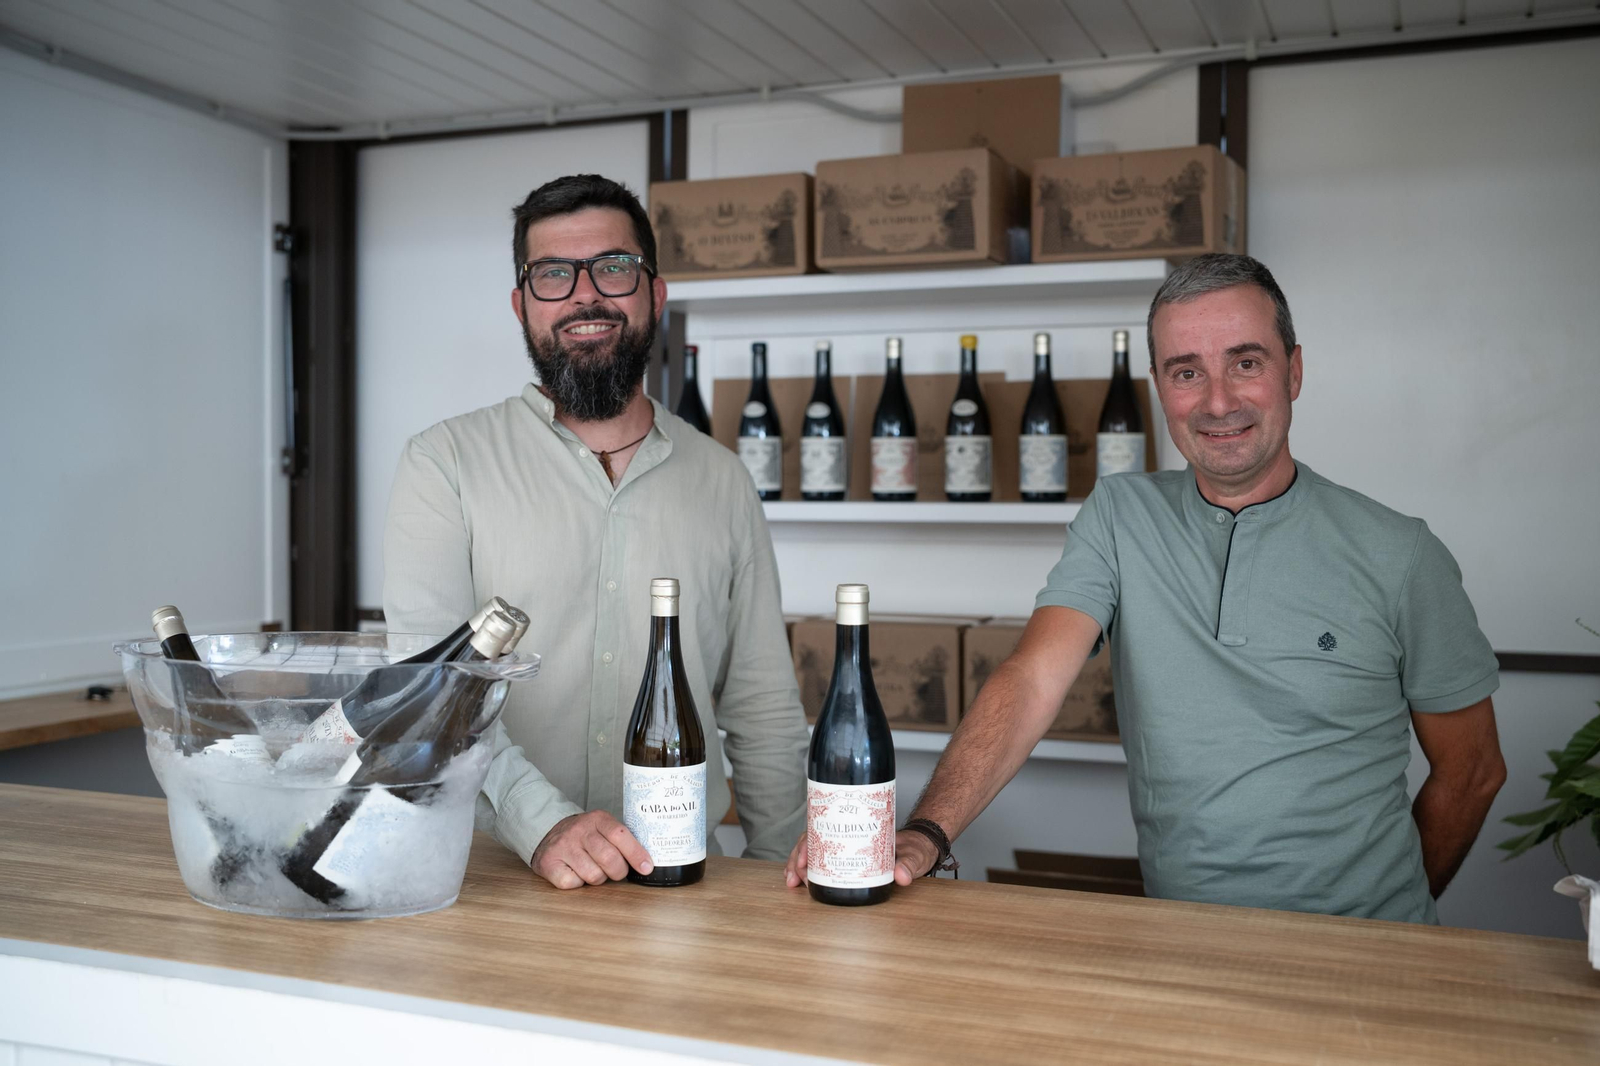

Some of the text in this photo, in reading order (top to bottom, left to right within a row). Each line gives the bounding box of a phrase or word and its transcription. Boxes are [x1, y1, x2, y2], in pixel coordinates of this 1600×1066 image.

[859, 795, 884, 807] GALICIA
[640, 804, 668, 813] GABA
[838, 805, 860, 814] 2021
